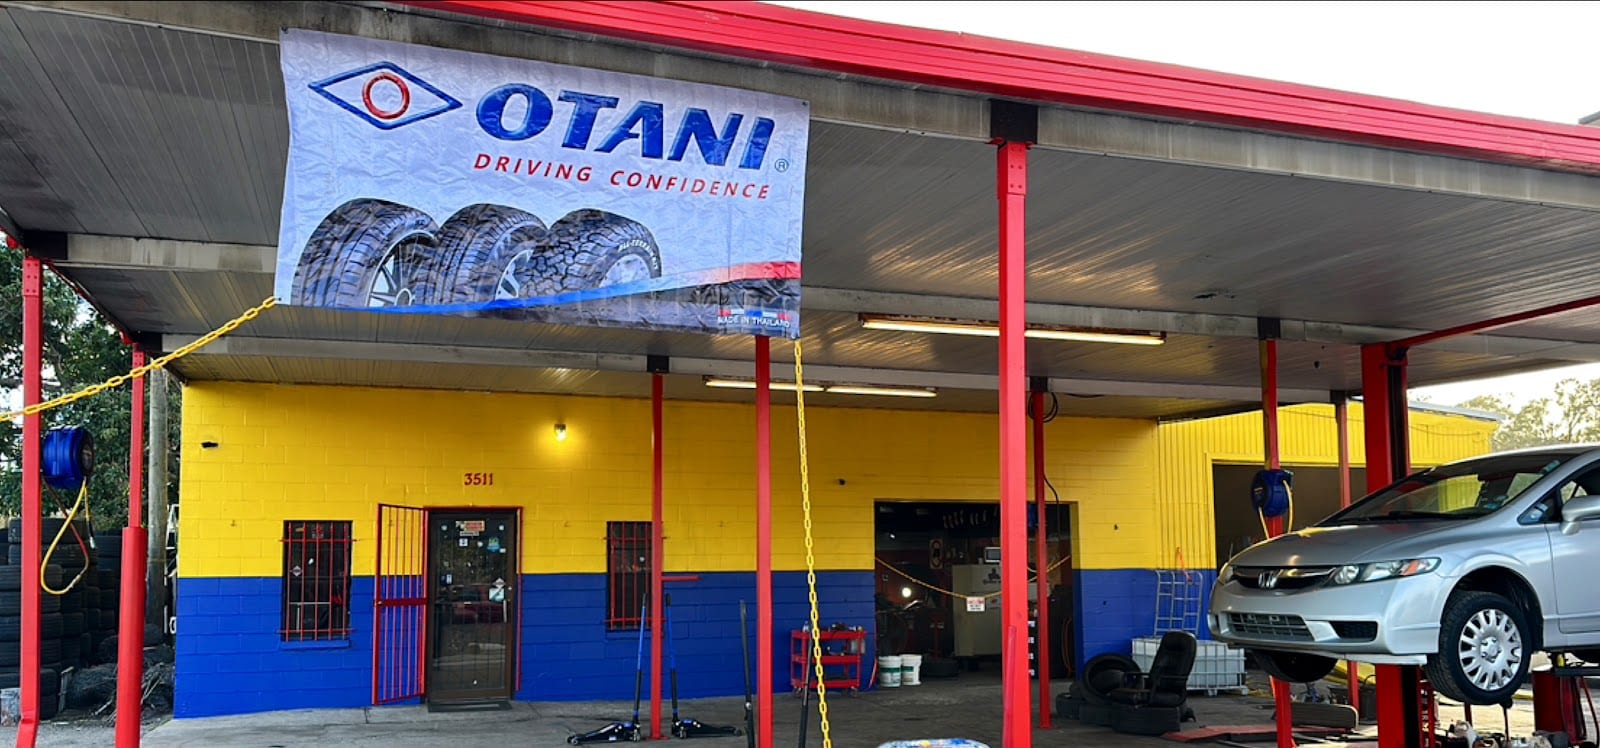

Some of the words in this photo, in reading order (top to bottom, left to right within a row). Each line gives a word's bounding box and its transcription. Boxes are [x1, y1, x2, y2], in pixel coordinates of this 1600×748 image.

[476, 83, 775, 170] OTANI
[474, 153, 592, 182] DRIVING
[610, 170, 770, 199] CONFIDENCE
[718, 316, 738, 324] MADE
[753, 317, 790, 328] THAILAND
[464, 472, 494, 486] 3511
